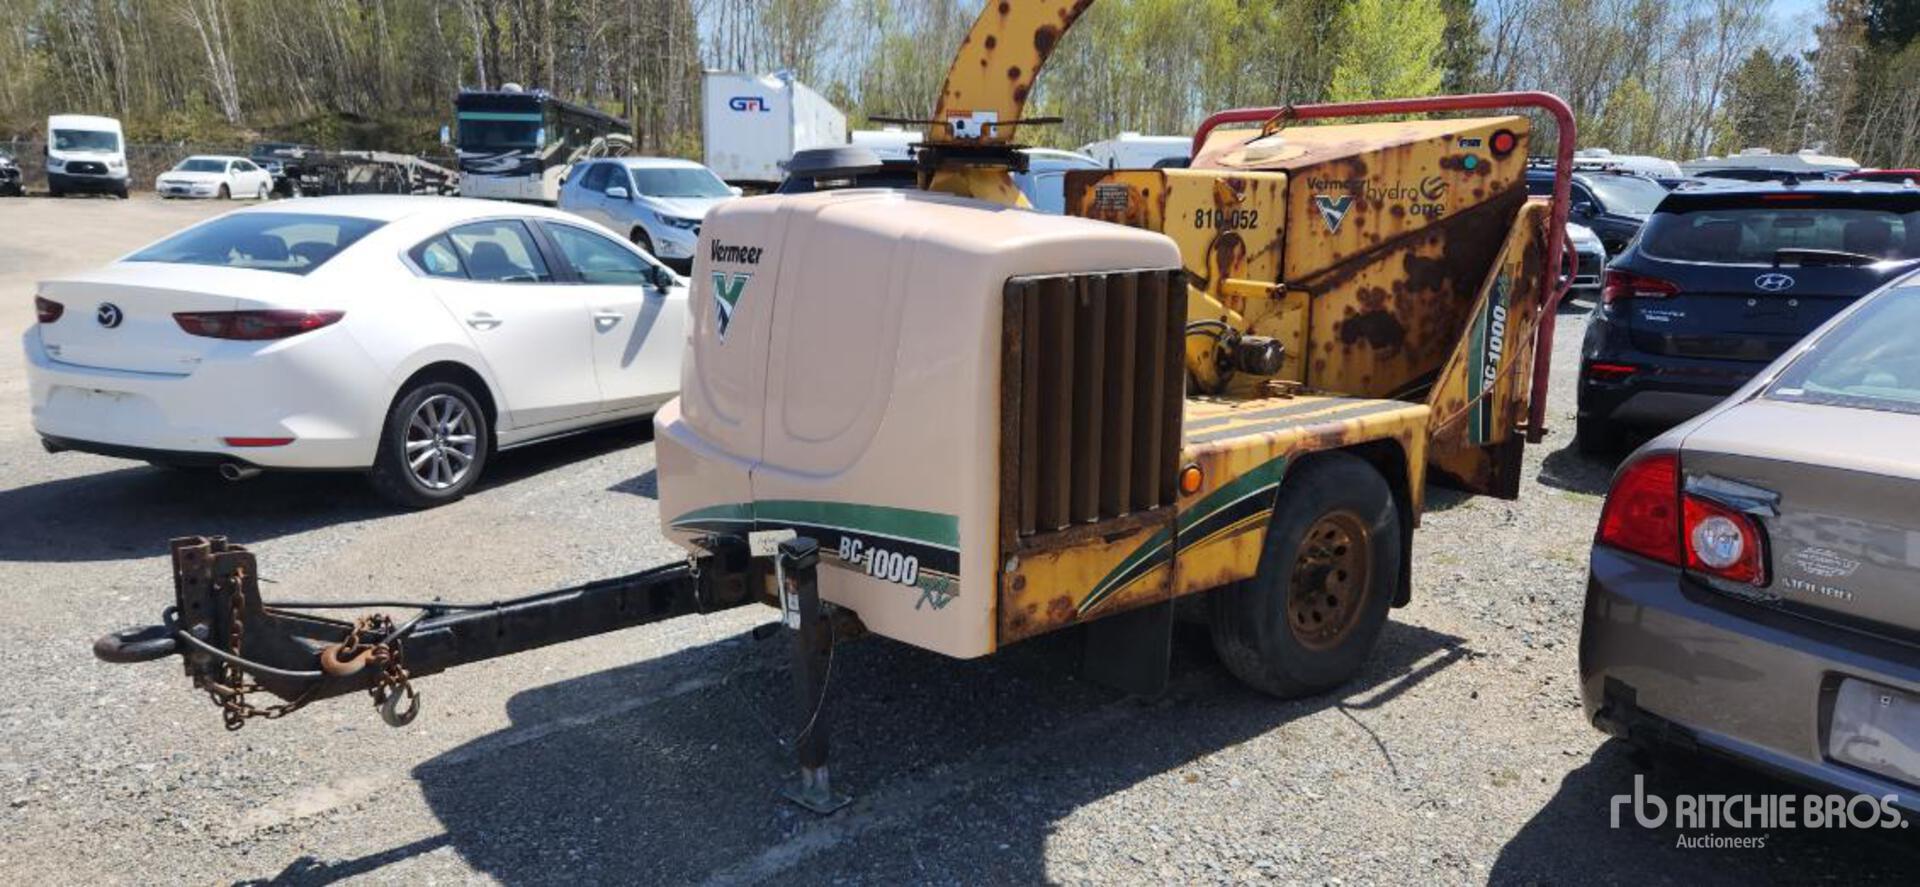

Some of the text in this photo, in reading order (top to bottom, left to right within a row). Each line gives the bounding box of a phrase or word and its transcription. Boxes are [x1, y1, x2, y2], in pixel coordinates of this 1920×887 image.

[729, 96, 770, 111] GFL
[1366, 179, 1419, 202] hydro
[1410, 203, 1445, 217] one
[711, 239, 763, 264] Vermeer
[839, 536, 919, 586] BC-1000
